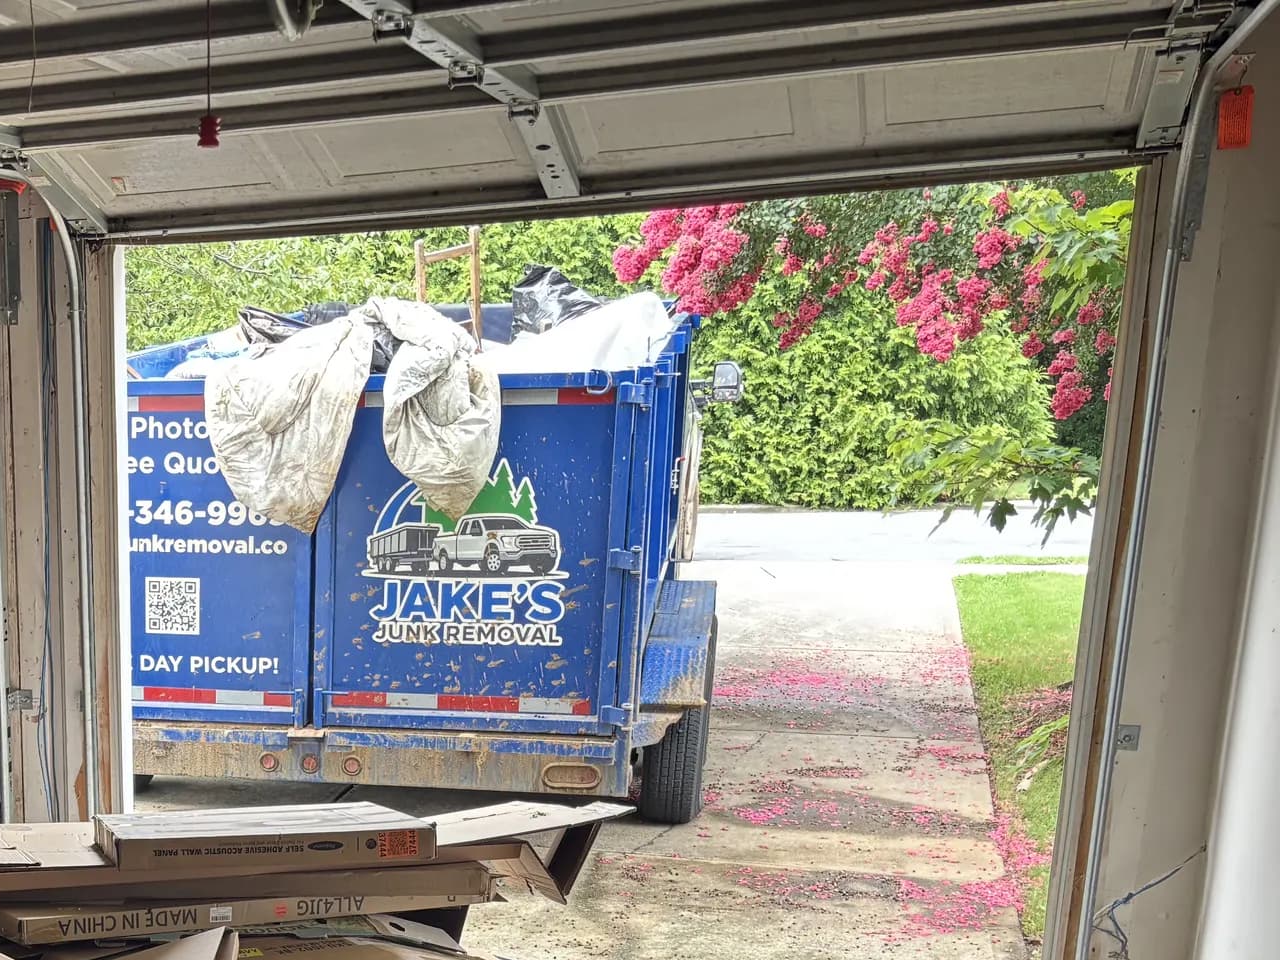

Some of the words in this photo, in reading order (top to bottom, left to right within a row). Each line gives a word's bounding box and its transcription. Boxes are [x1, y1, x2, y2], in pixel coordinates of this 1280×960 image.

[164, 451, 220, 474] Quo
[370, 580, 565, 623] JAKE'S
[373, 622, 441, 645] JUNK
[443, 623, 562, 646] REMOVAL
[139, 655, 184, 673] DAY
[190, 656, 280, 675] PICKUP!
[153, 848, 179, 857] PANEL
[181, 847, 202, 856] WALL
[204, 846, 243, 855] ACOUSTIC
[58, 916, 117, 936] CHINA
[122, 911, 139, 928] IN
[146, 907, 198, 928] MADE
